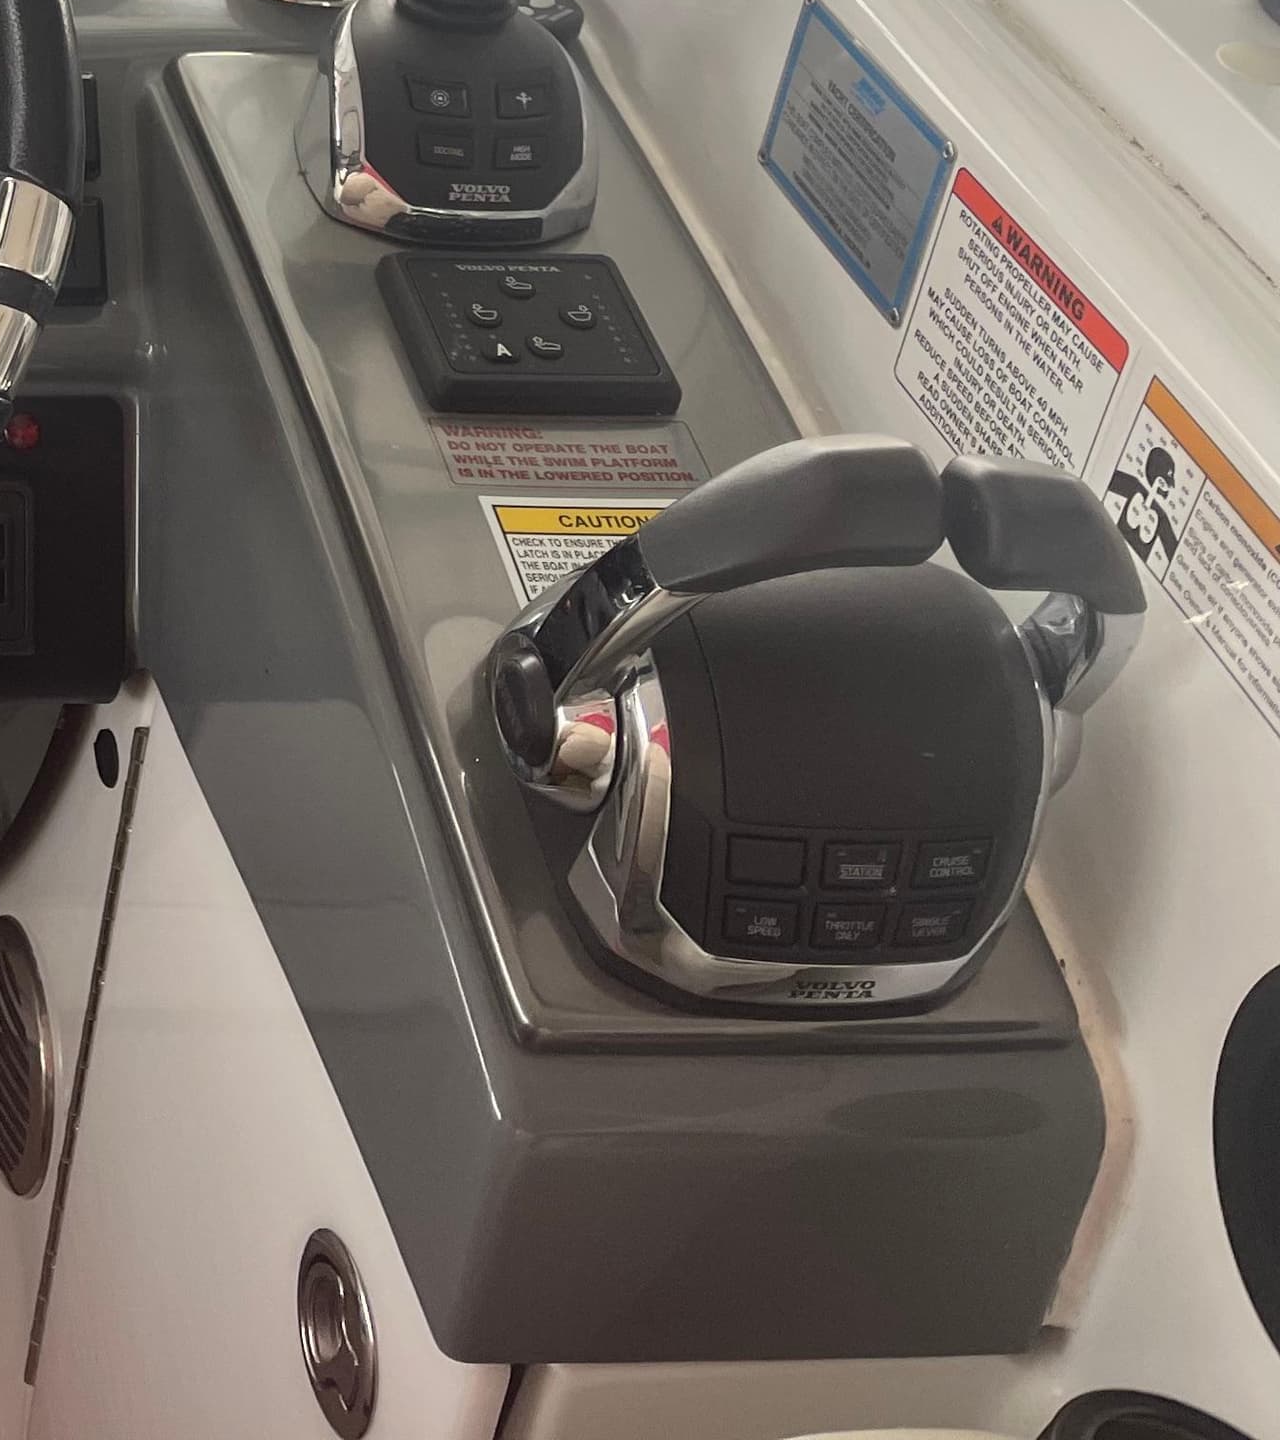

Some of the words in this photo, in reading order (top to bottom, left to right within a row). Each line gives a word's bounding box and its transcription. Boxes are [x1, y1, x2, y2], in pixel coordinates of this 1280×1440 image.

[450, 183, 511, 194] VOLVO
[447, 191, 512, 203] PENTA
[455, 263, 507, 272] VOLVO
[507, 263, 562, 273] PENTA
[1004, 225, 1087, 323] WARNING
[958, 208, 1000, 259] ROTATING
[998, 252, 1052, 316] PROPELLER
[1051, 310, 1071, 337] MAY
[1070, 332, 1104, 373] CAUSE
[966, 237, 1005, 284] SERIOUS
[1003, 278, 1036, 318] INJURY
[1034, 313, 1050, 335] OR
[1049, 329, 1083, 371] DEATH.
[957, 246, 980, 277] SHUT
[979, 271, 997, 296] OFF
[997, 291, 1030, 332] ENGINE
[1029, 327, 1057, 363] WHEN
[1056, 358, 1084, 393] NEAR
[962, 273, 1004, 323] PERSONS
[1013, 329, 1032, 355] THE
[1031, 350, 1066, 394] WATER.
[496, 342, 513, 358] A
[926, 286, 945, 312] MAY
[943, 306, 973, 344] CAUSE
[971, 339, 996, 371] LOSS
[995, 365, 1008, 386] OF
[1007, 381, 1033, 414] BOAT
[927, 306, 956, 343] WHICH
[954, 338, 984, 377] COULD
[982, 372, 1017, 416] RESULT
[943, 286, 978, 330] SUDDEN
[976, 324, 1007, 364] TURNS
[1005, 358, 1036, 398] ABOVE
[1035, 393, 1047, 412] 40
[1047, 407, 1068, 436] MPH
[913, 328, 947, 371] REDUCE
[945, 365, 975, 404] SPEED
[972, 398, 1009, 446] BEFORE
[916, 370, 941, 402] READ
[937, 397, 979, 448] OWNER'S
[938, 379, 975, 425] SUDDEN
[951, 356, 983, 396] INJURY
[982, 391, 996, 412] OR
[995, 407, 1028, 449] DEATH.
[441, 424, 544, 440] WARNING:
[447, 441, 471, 451] DO
[475, 441, 507, 452] NOT
[512, 442, 587, 454] OPERATE
[589, 444, 622, 455] THE
[625, 444, 669, 455] BOAT
[452, 454, 504, 466] WHILE
[507, 455, 539, 467] THE
[543, 456, 589, 468] SWIM
[591, 457, 678, 469] PLATFORM
[457, 468, 474, 478] IS
[477, 468, 495, 479] IN
[497, 469, 530, 480] THE
[533, 470, 614, 482] LOWERED
[617, 471, 699, 483] POSITION.
[1202, 488, 1231, 528] Carbon
[1229, 522, 1268, 572] monoxide
[511, 537, 546, 548] CHECK
[549, 538, 562, 548] TO
[564, 538, 604, 549] ENSURE
[515, 550, 549, 559] LATCH
[551, 550, 561, 559] IS
[562, 550, 573, 559] IN
[520, 561, 545, 571] THE
[546, 561, 570, 571] BOAT
[530, 585, 538, 594] IF
[931, 855, 970, 867] CRUISE
[839, 866, 885, 878] STATION
[927, 865, 976, 879] CONTROL
[753, 914, 778, 927] LOW
[824, 919, 876, 932] THROTTLE
[746, 924, 782, 938] SPEED
[834, 929, 861, 942] ONLY
[795, 979, 877, 991] VOLVO
[789, 989, 874, 1000] PENTA
